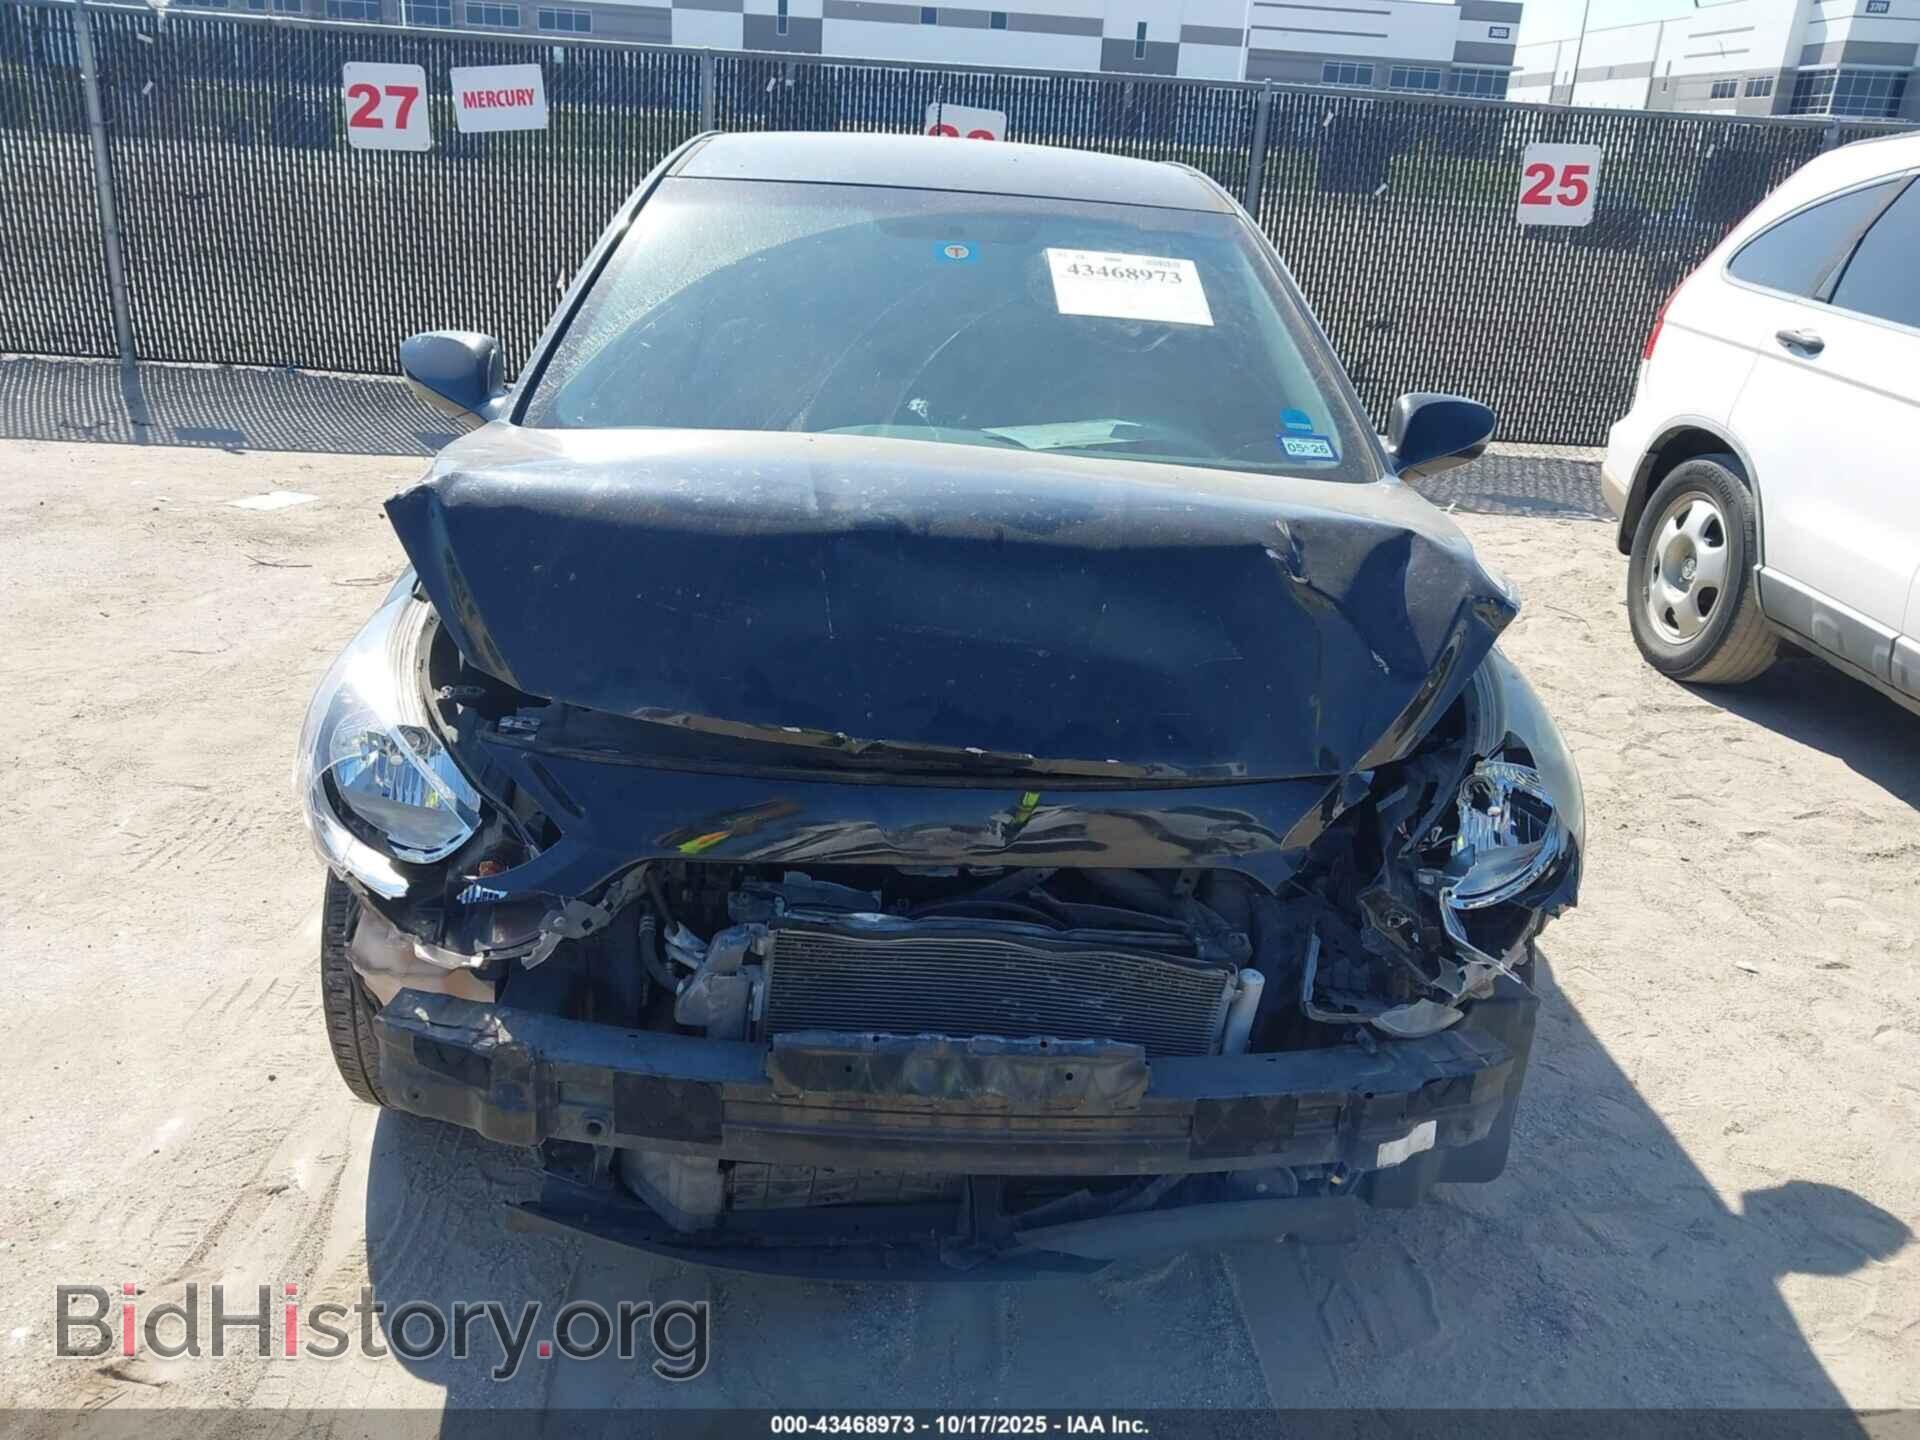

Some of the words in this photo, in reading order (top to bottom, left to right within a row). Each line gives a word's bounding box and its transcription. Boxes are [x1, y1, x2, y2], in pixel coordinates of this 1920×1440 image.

[347, 83, 419, 130] 27
[462, 88, 536, 110] MERCURY
[1519, 162, 1591, 207] 25
[1066, 262, 1183, 285] 43468973
